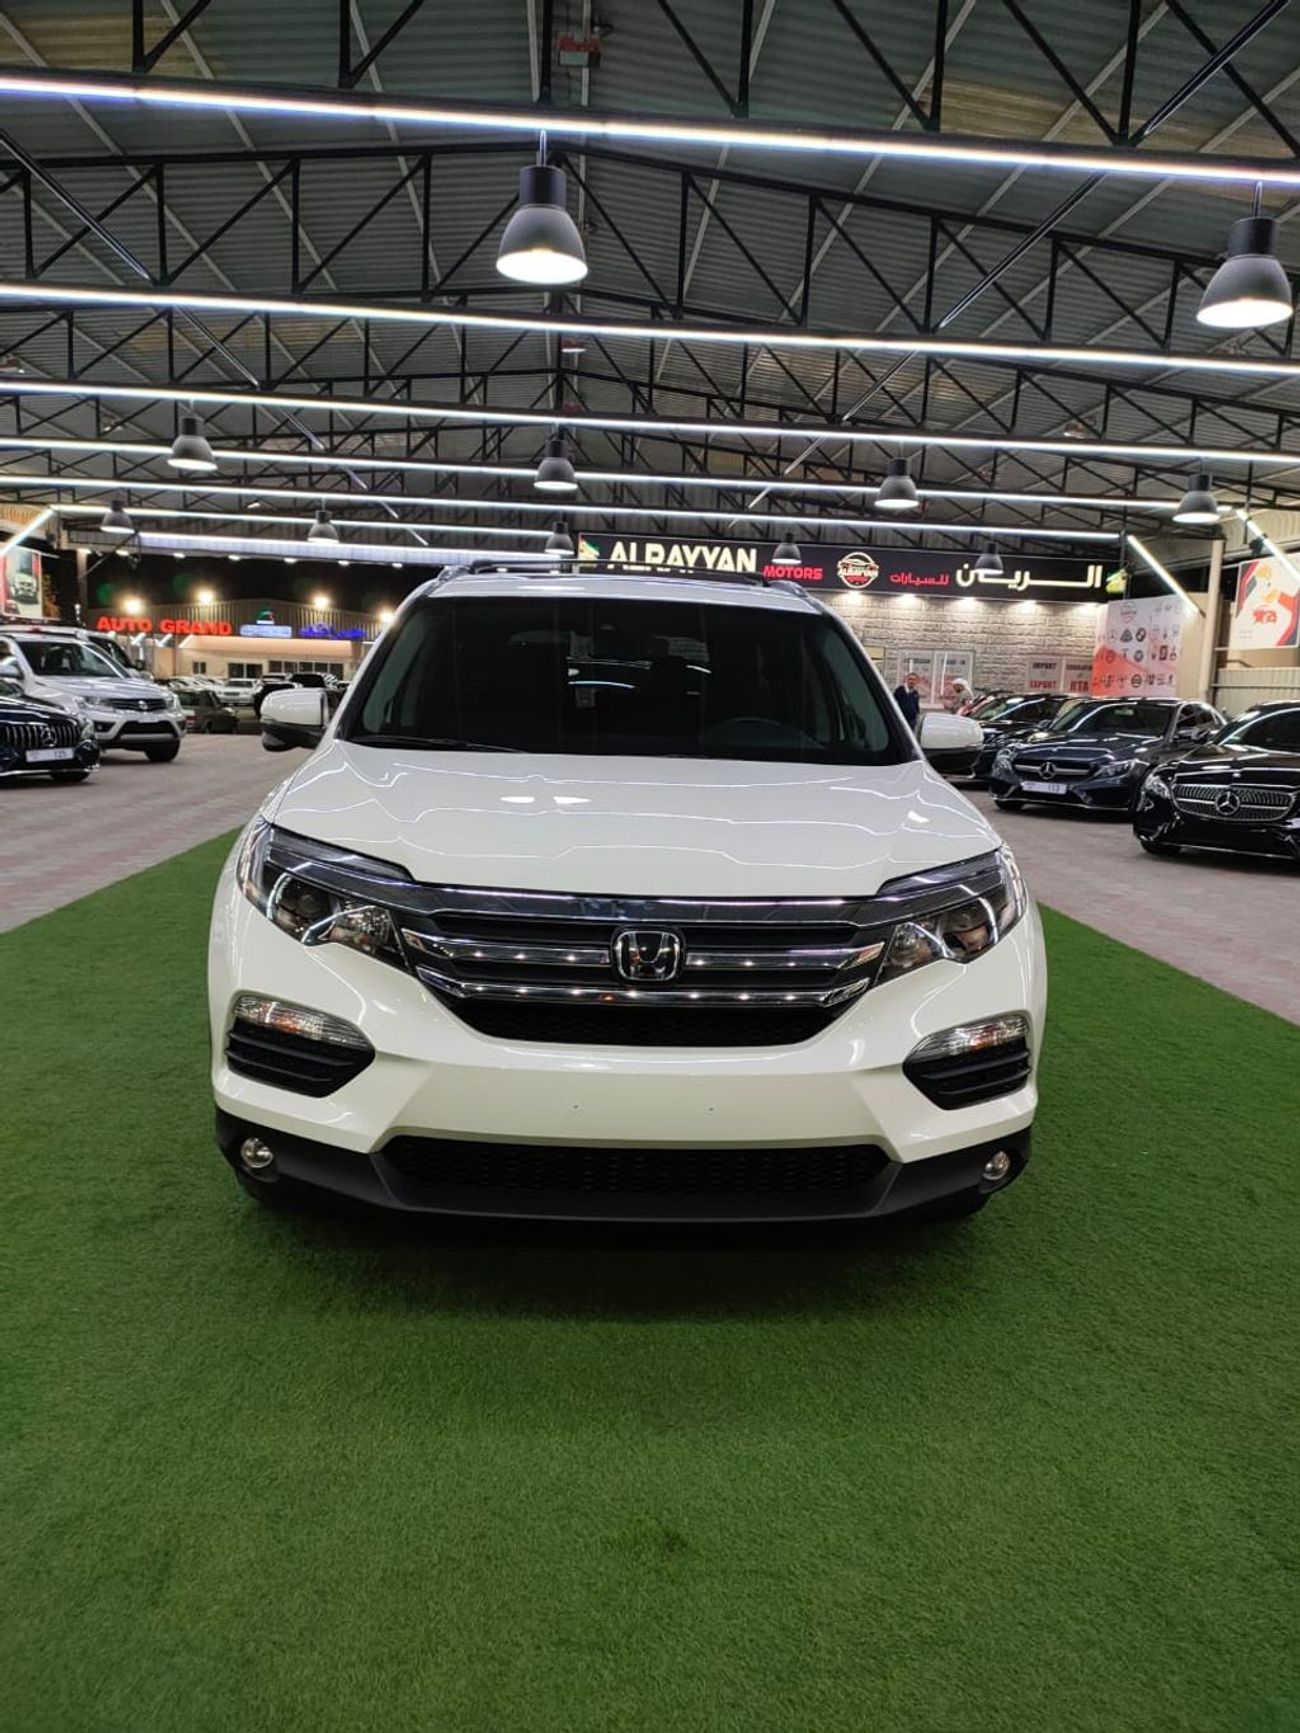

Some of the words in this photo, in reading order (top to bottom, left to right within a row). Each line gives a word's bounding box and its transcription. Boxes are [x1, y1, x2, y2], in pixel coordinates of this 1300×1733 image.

[607, 541, 757, 573] ALRAYYAN
[762, 565, 824, 580] MOTORS
[889, 571, 949, 587] للسيارات
[97, 615, 152, 633] AUTO
[160, 619, 233, 636] GRAND
